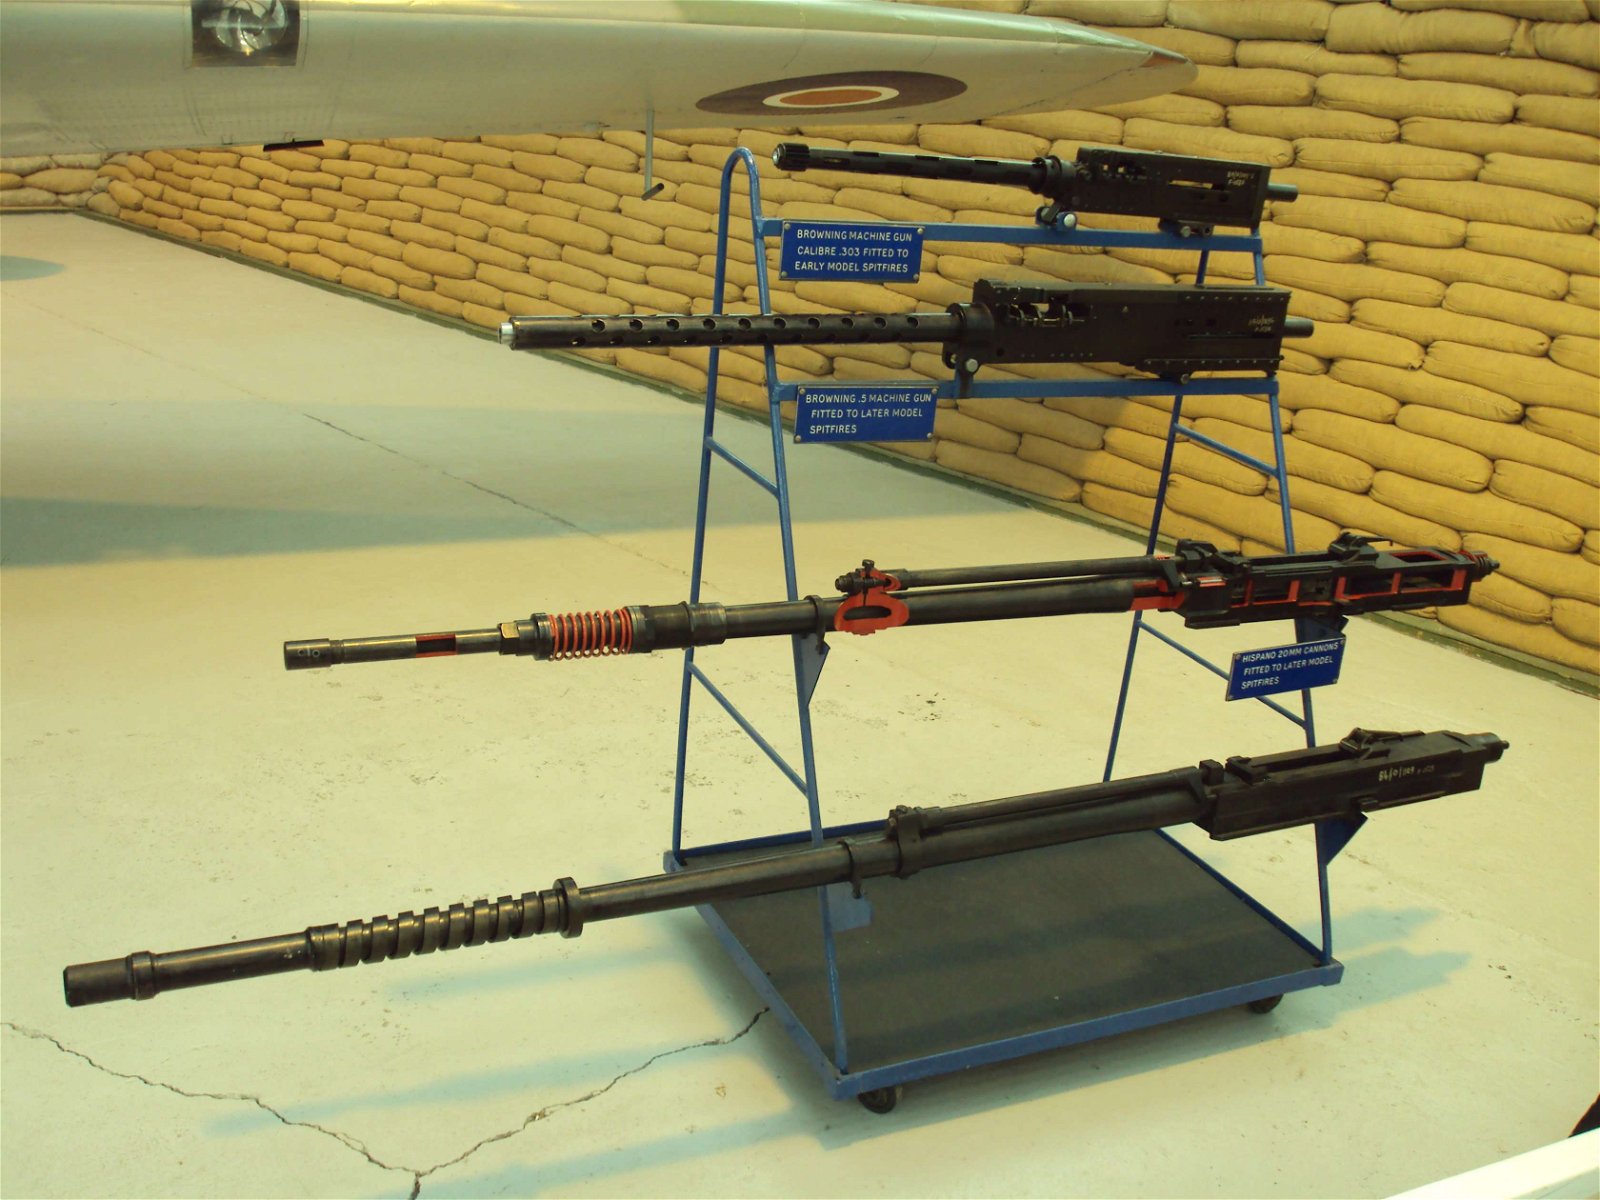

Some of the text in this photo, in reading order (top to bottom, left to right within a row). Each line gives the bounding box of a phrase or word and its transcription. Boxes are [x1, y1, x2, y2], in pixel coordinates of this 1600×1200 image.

[797, 229, 912, 242] BROWNING MACHINE GUN
[797, 246, 909, 258] CALIBRE .303 FITTED TO
[795, 261, 908, 273] EARLY MODEL SPITFIRES
[806, 394, 932, 403] BROWNING .5 MACHINE GUN
[811, 408, 923, 418] FITTED TO LATER MODEL
[810, 425, 857, 434] SPITFIRES
[1242, 642, 1339, 663] HISPANO 20MM CANNONS
[1244, 656, 1333, 676] FITTED TO LATER MODEL
[1241, 677, 1280, 690] SPITFIRES
